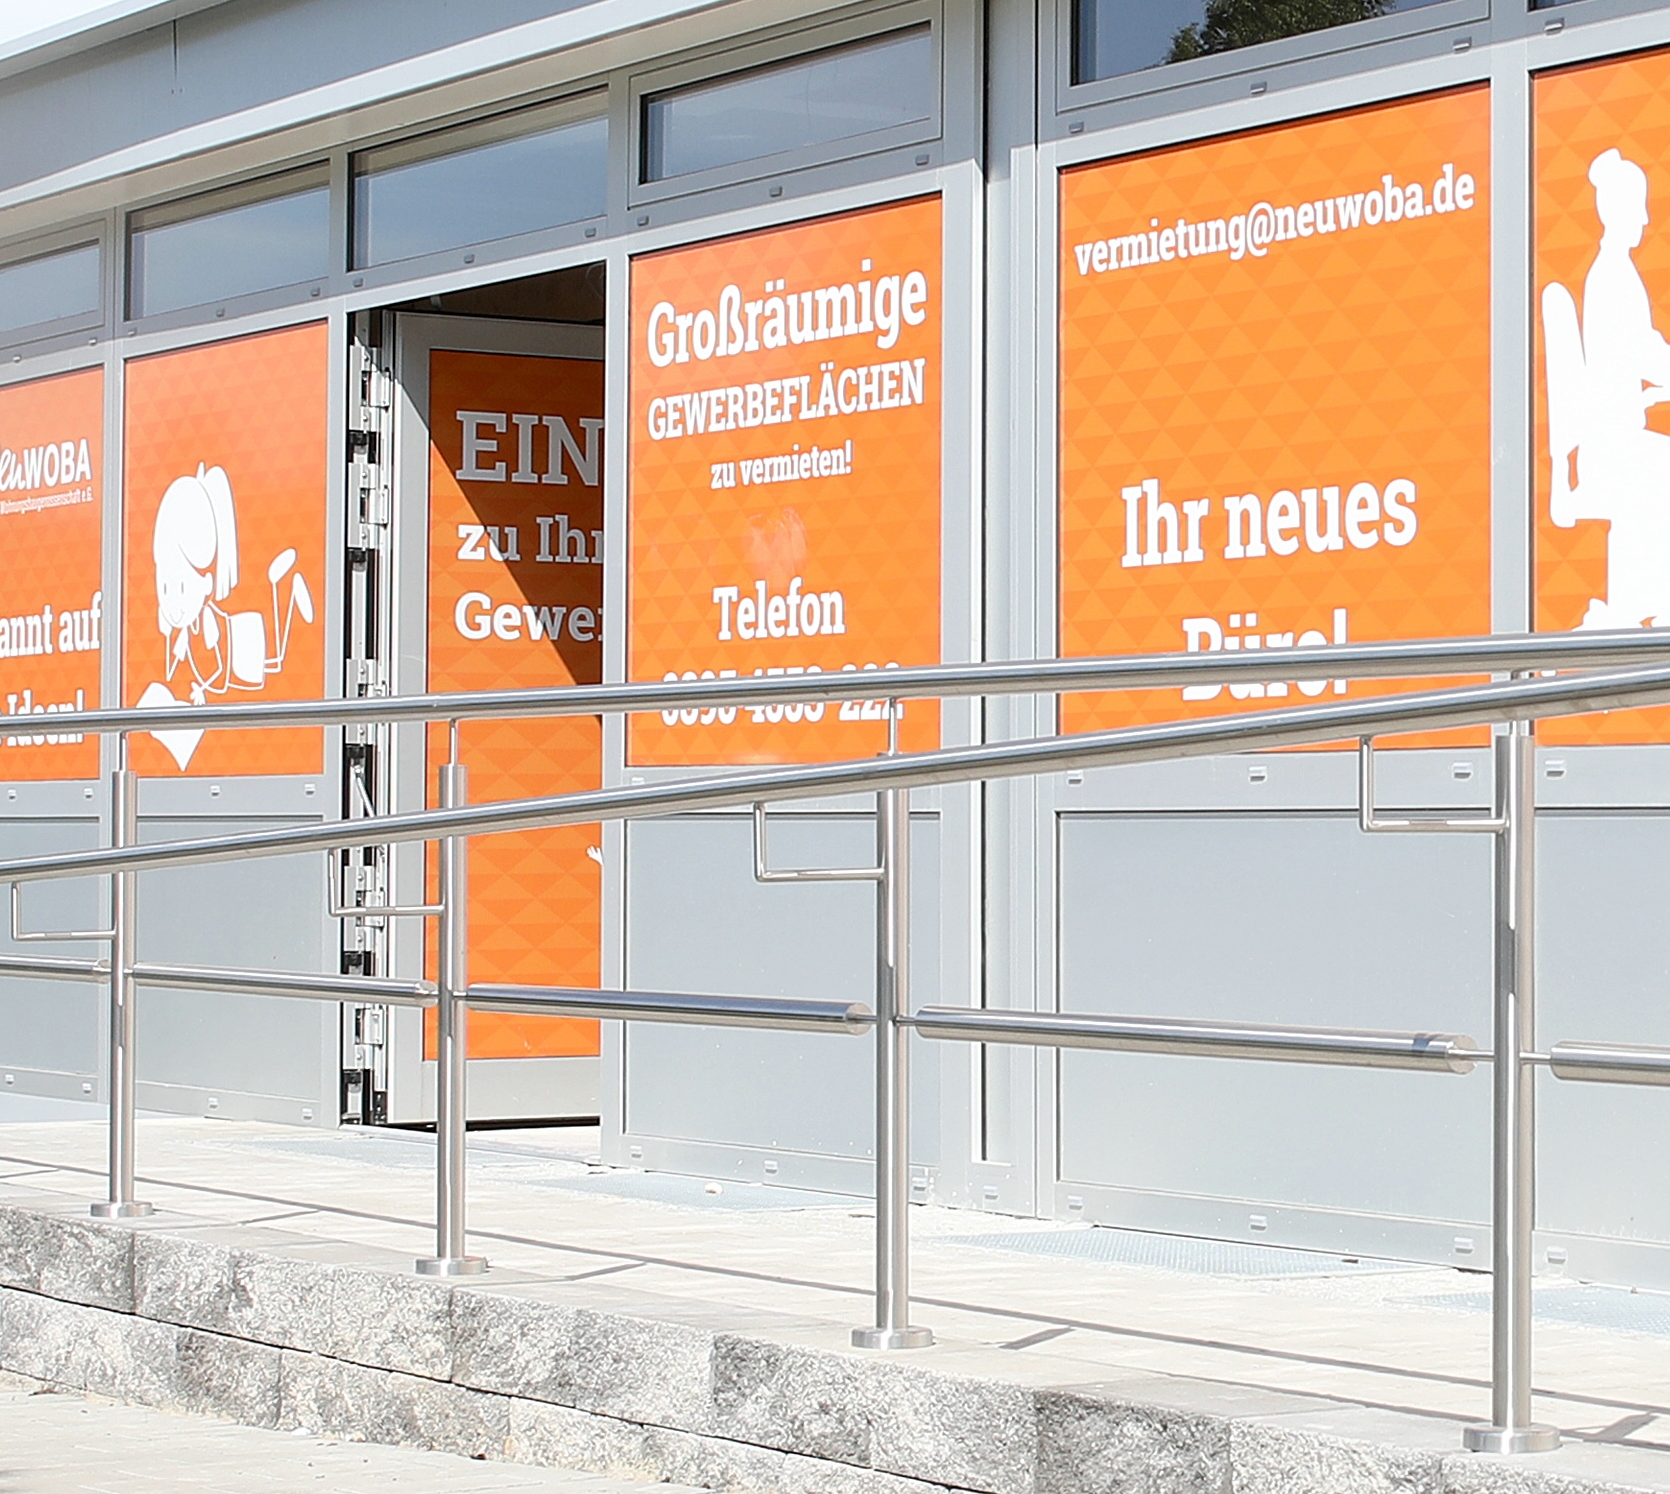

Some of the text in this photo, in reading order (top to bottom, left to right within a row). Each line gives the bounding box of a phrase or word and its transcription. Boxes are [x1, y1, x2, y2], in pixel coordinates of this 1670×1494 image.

[1073, 162, 1476, 276] vermietung@neuwoba.de
[646, 258, 928, 367] Großräumige
[647, 357, 926, 441] GEWERBEFLÄCHEN
[710, 439, 853, 490] zu vermieten!
[457, 523, 522, 562] zu
[1120, 478, 1418, 568] Ihr neues
[58, 590, 102, 654] auf
[454, 591, 603, 642] Gewe
[712, 576, 846, 641] Telefon
